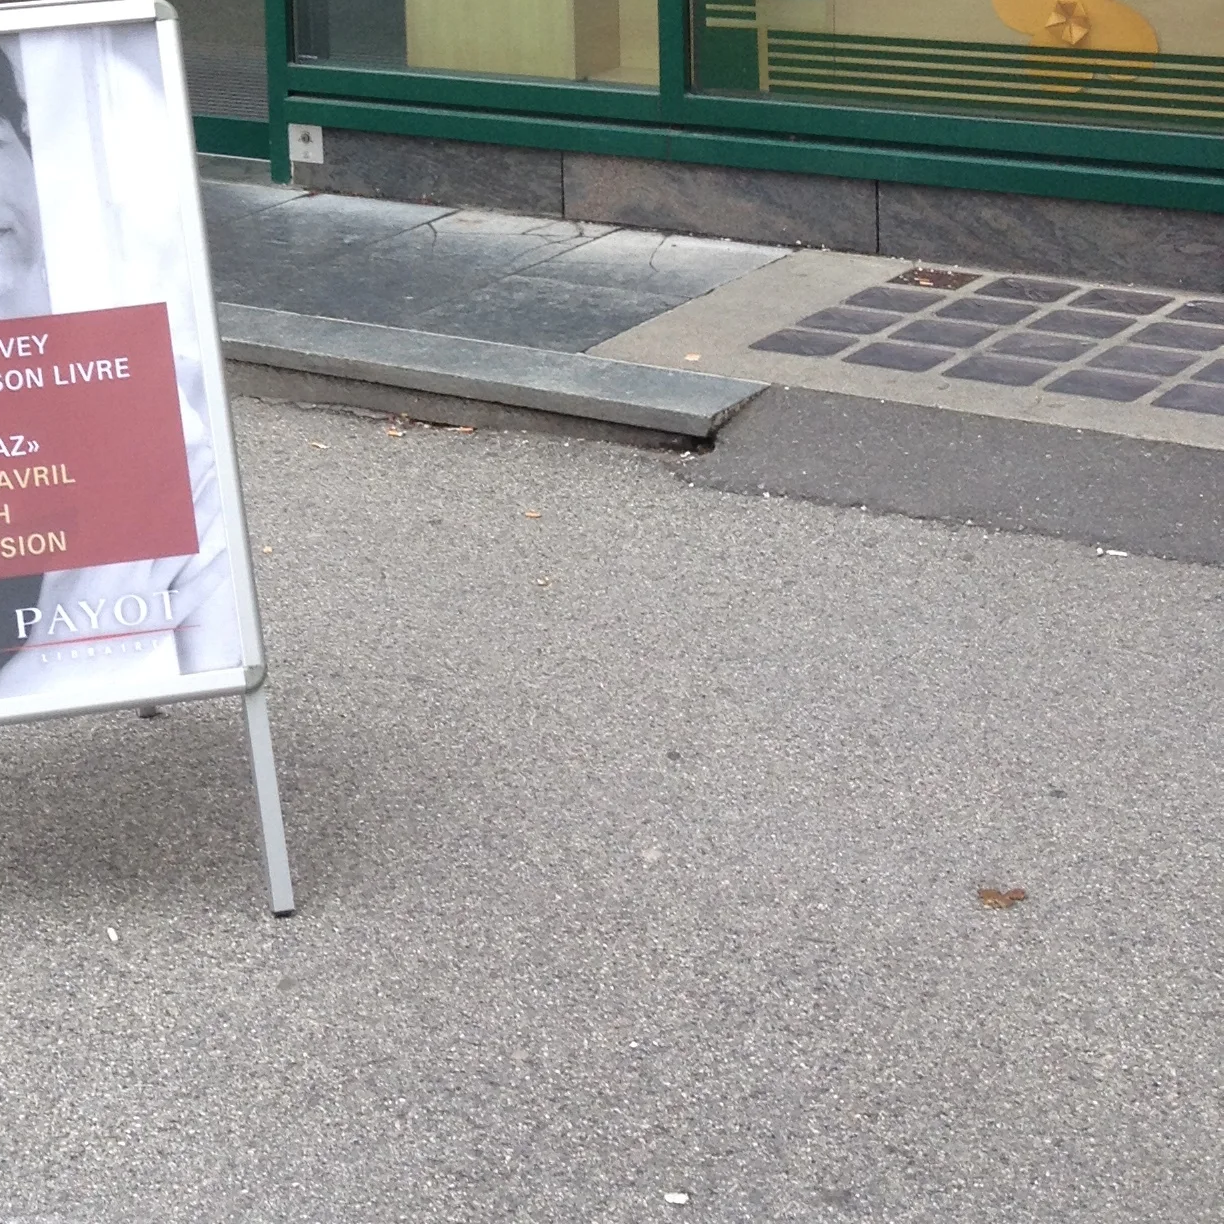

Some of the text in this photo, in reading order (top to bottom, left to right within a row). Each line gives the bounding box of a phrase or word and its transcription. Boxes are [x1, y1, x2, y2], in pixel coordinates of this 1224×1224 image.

[54, 357, 131, 387] LIVRE
[0, 531, 68, 559] SION
[15, 589, 179, 639] PAYOT
